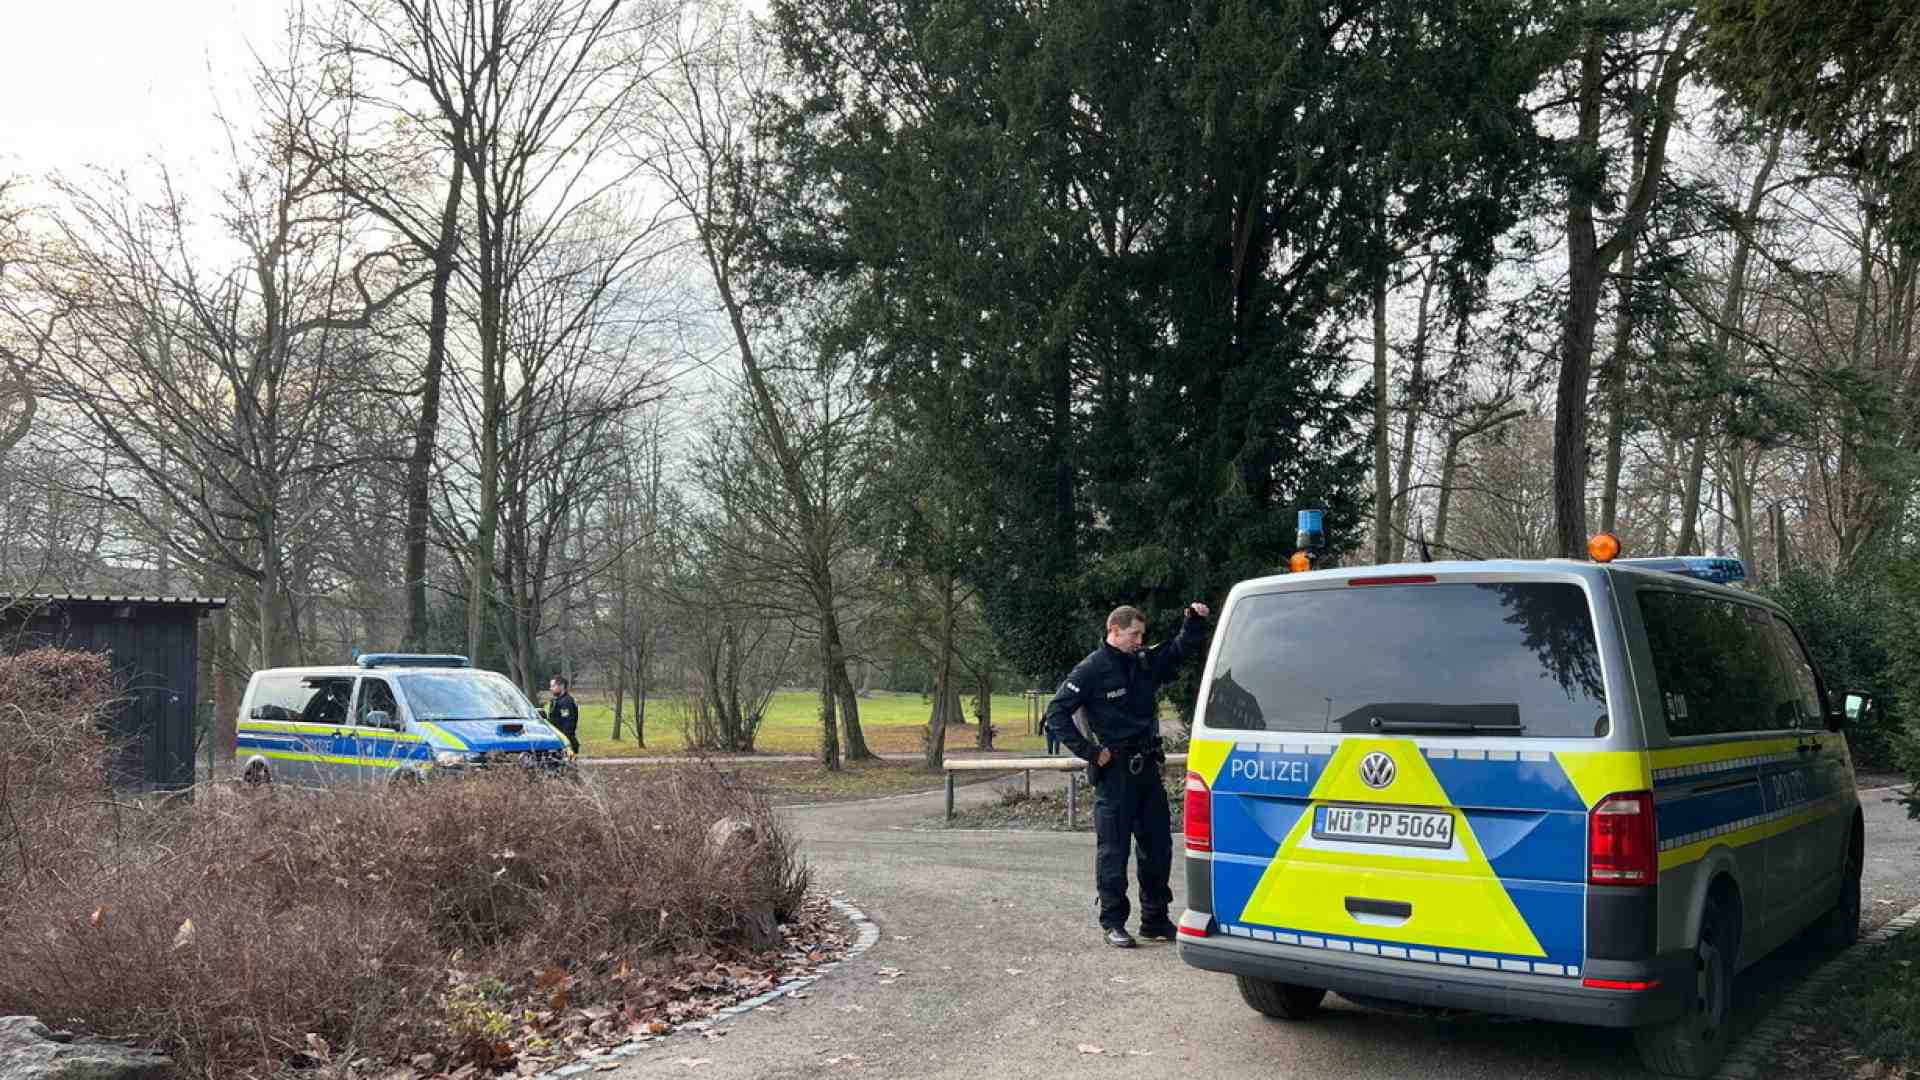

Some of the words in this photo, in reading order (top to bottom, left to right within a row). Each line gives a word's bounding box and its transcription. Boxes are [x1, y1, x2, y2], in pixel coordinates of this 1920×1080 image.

[1231, 759, 1309, 782] POLIZEI
[1328, 810, 1351, 832] WÜ
[1367, 813, 1392, 835] PP
[1396, 815, 1449, 840] 5064
